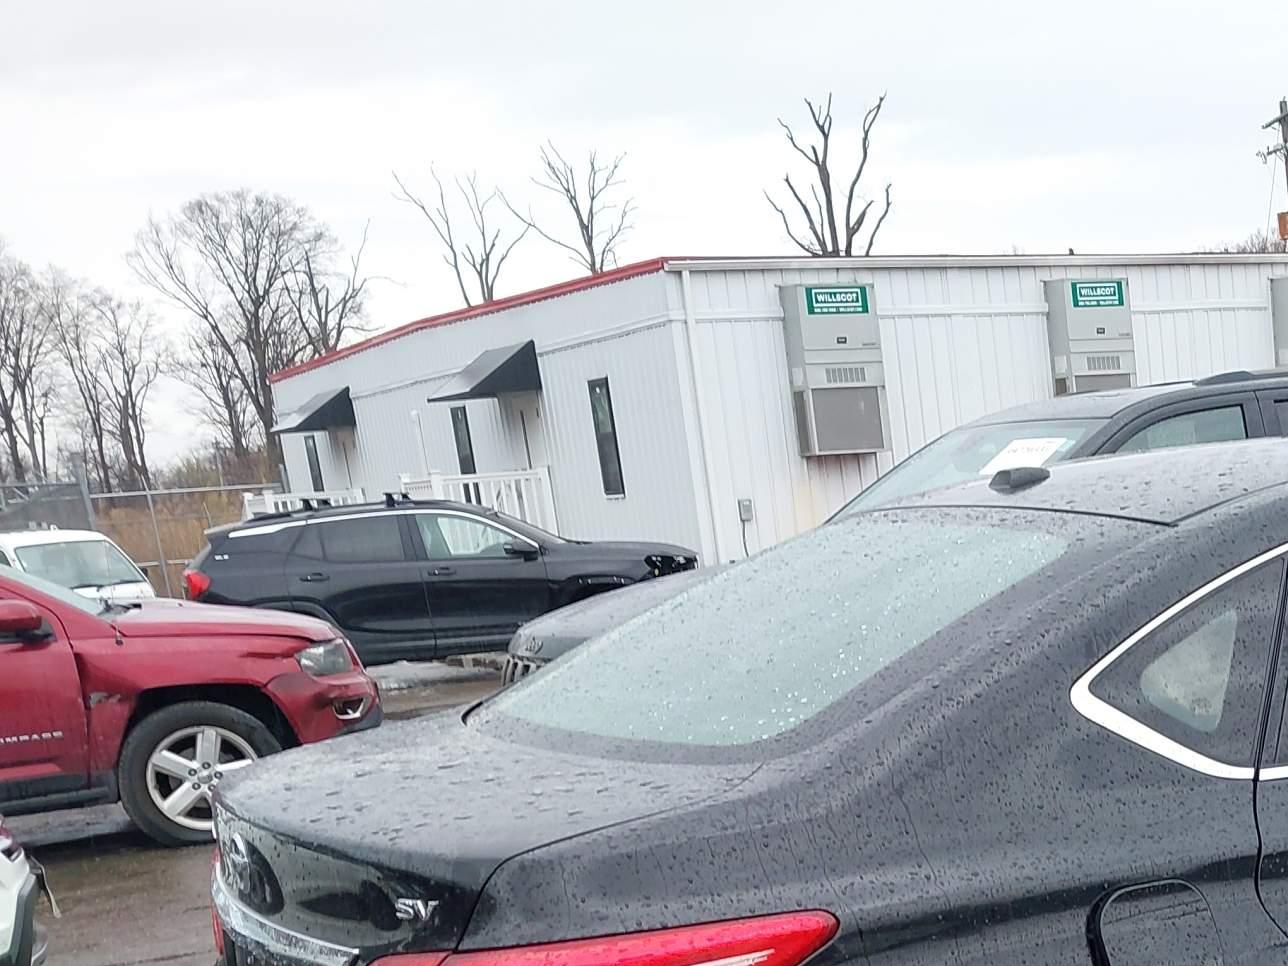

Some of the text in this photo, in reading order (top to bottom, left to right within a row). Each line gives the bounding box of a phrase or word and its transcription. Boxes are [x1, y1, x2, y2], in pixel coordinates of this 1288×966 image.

[1080, 287, 1115, 296] WILLSCOT
[816, 292, 857, 303] WILLSCOT
[395, 898, 439, 920] SV
